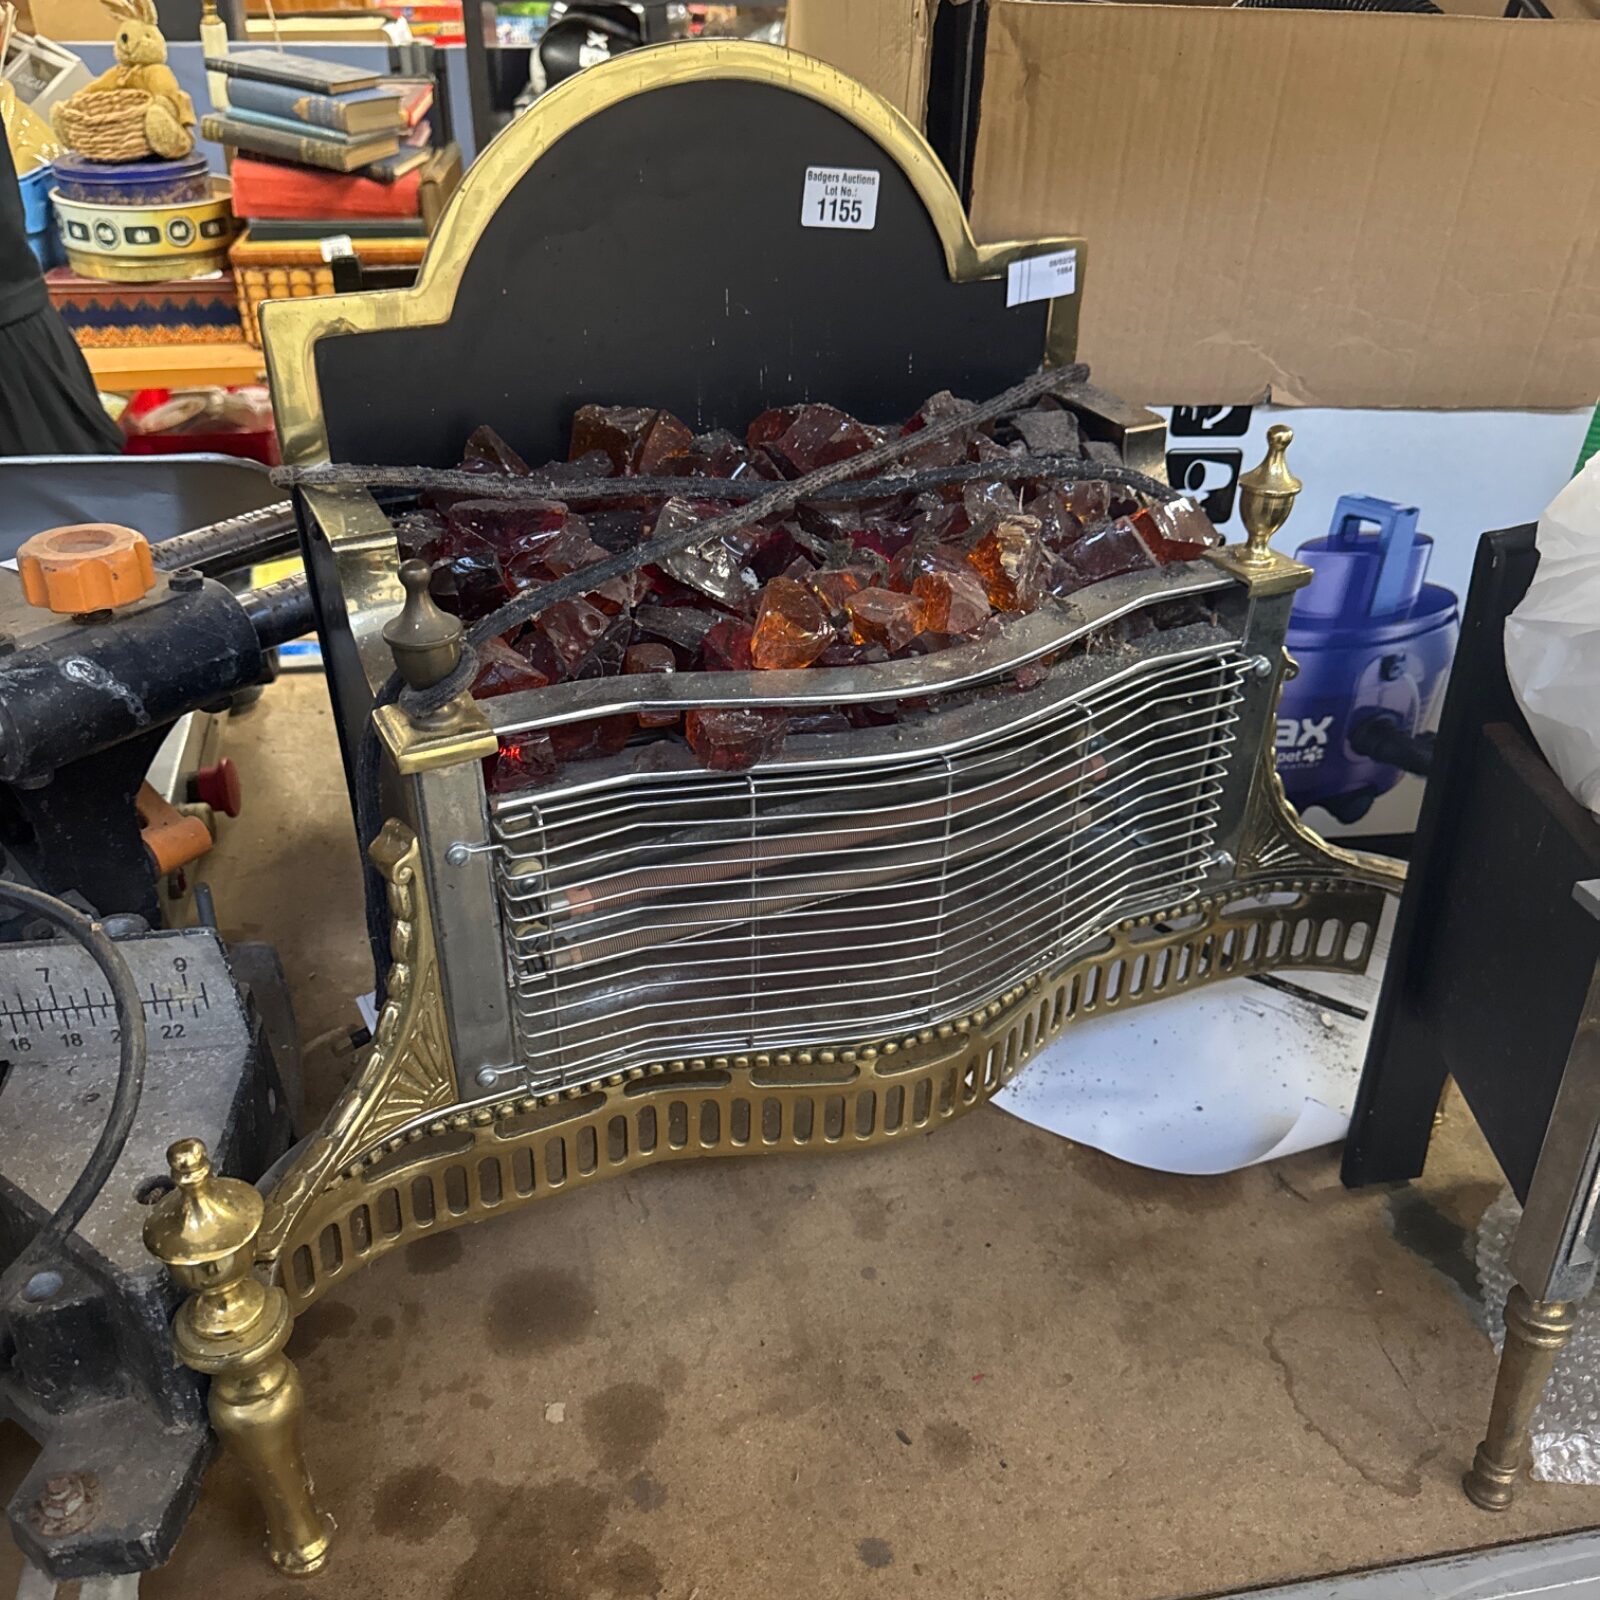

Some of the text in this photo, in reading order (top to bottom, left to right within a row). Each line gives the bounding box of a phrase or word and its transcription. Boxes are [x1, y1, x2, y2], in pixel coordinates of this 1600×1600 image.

[807, 170, 876, 186] Badgers Auctions
[825, 185, 838, 196] Lot
[817, 197, 862, 223] 1155
[1275, 716, 1333, 747] ax
[35, 957, 188, 983] 7 9
[9, 1037, 32, 1052] 16
[60, 1032, 84, 1048] 18
[160, 1023, 187, 1040] 22
